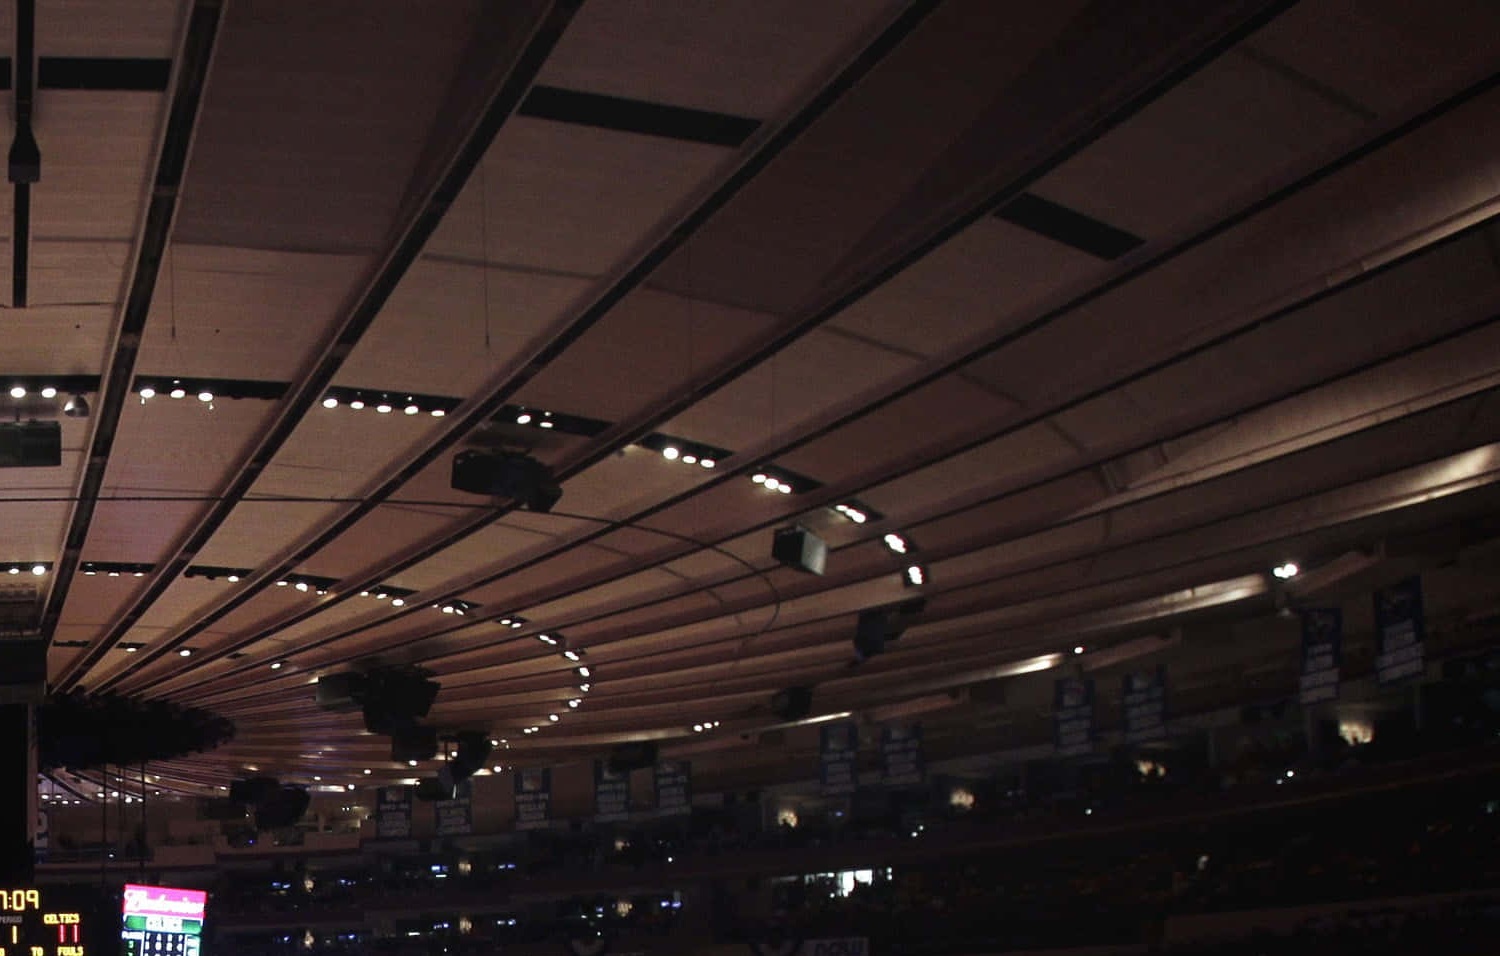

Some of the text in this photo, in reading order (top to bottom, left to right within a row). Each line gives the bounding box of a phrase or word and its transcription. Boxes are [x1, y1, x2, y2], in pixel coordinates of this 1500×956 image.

[44, 913, 80, 924] CELTICS
[12, 925, 17, 944] 1
[60, 924, 78, 943] 11
[57, 946, 84, 956] FOULS
